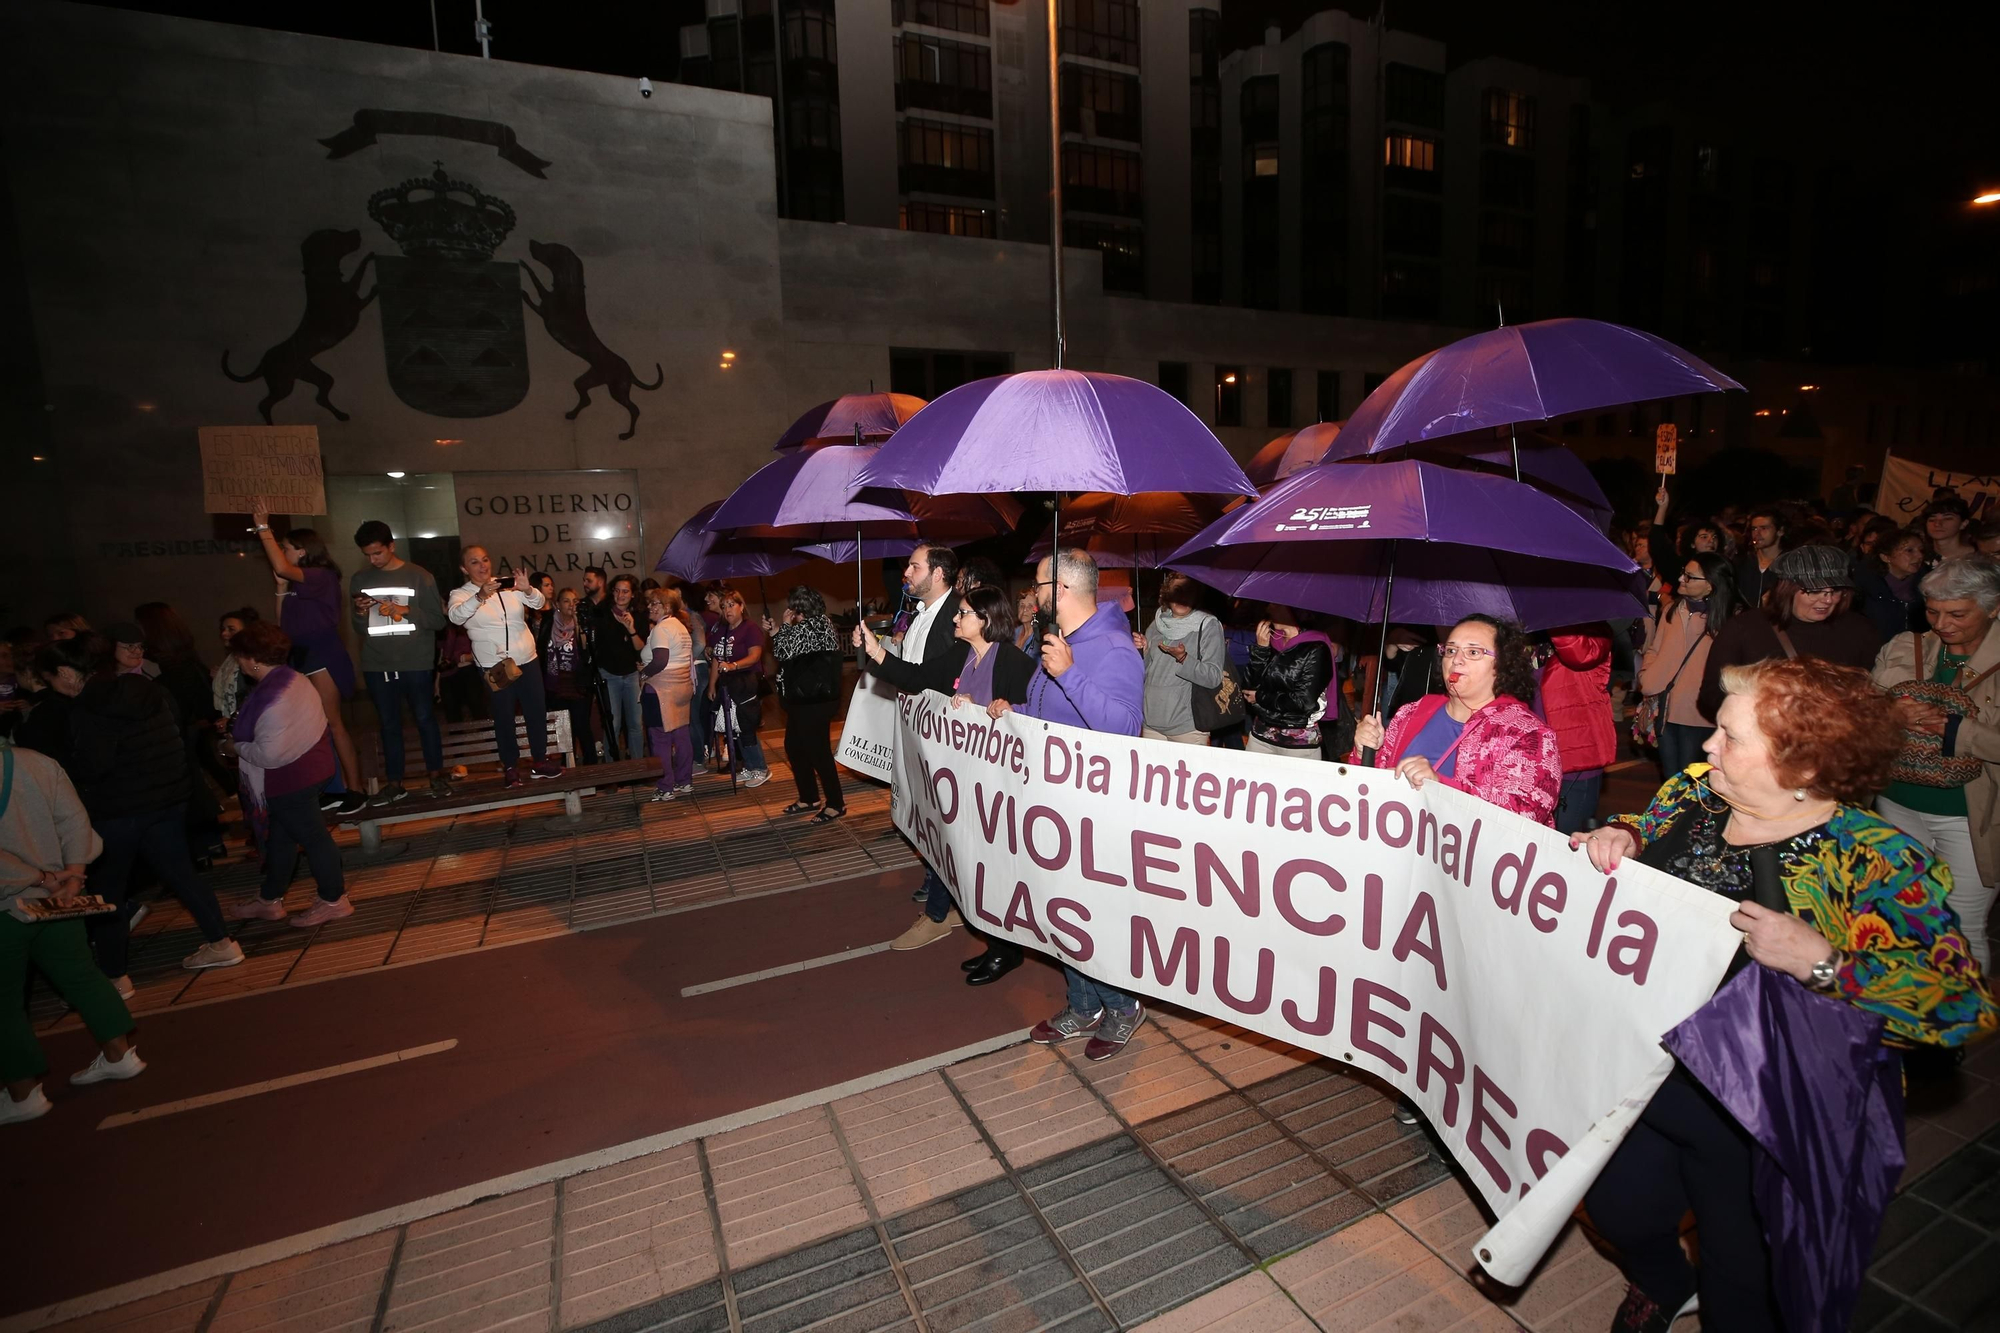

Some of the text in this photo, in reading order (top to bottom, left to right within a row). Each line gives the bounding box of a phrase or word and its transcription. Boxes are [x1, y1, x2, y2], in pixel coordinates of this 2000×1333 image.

[464, 493, 632, 516] GOBIERNO
[531, 523, 572, 544] DE
[496, 551, 637, 575] ANARIAS
[844, 746, 887, 771] CONCEJALIA
[912, 696, 1030, 785] Noviembre,
[1043, 734, 1111, 796] Dia
[1129, 749, 1482, 889] Internacional
[1491, 842, 1568, 933] de
[1586, 877, 1660, 987] la
[918, 752, 1448, 991] NO VIOLENCIA
[975, 861, 1095, 963] LAS
